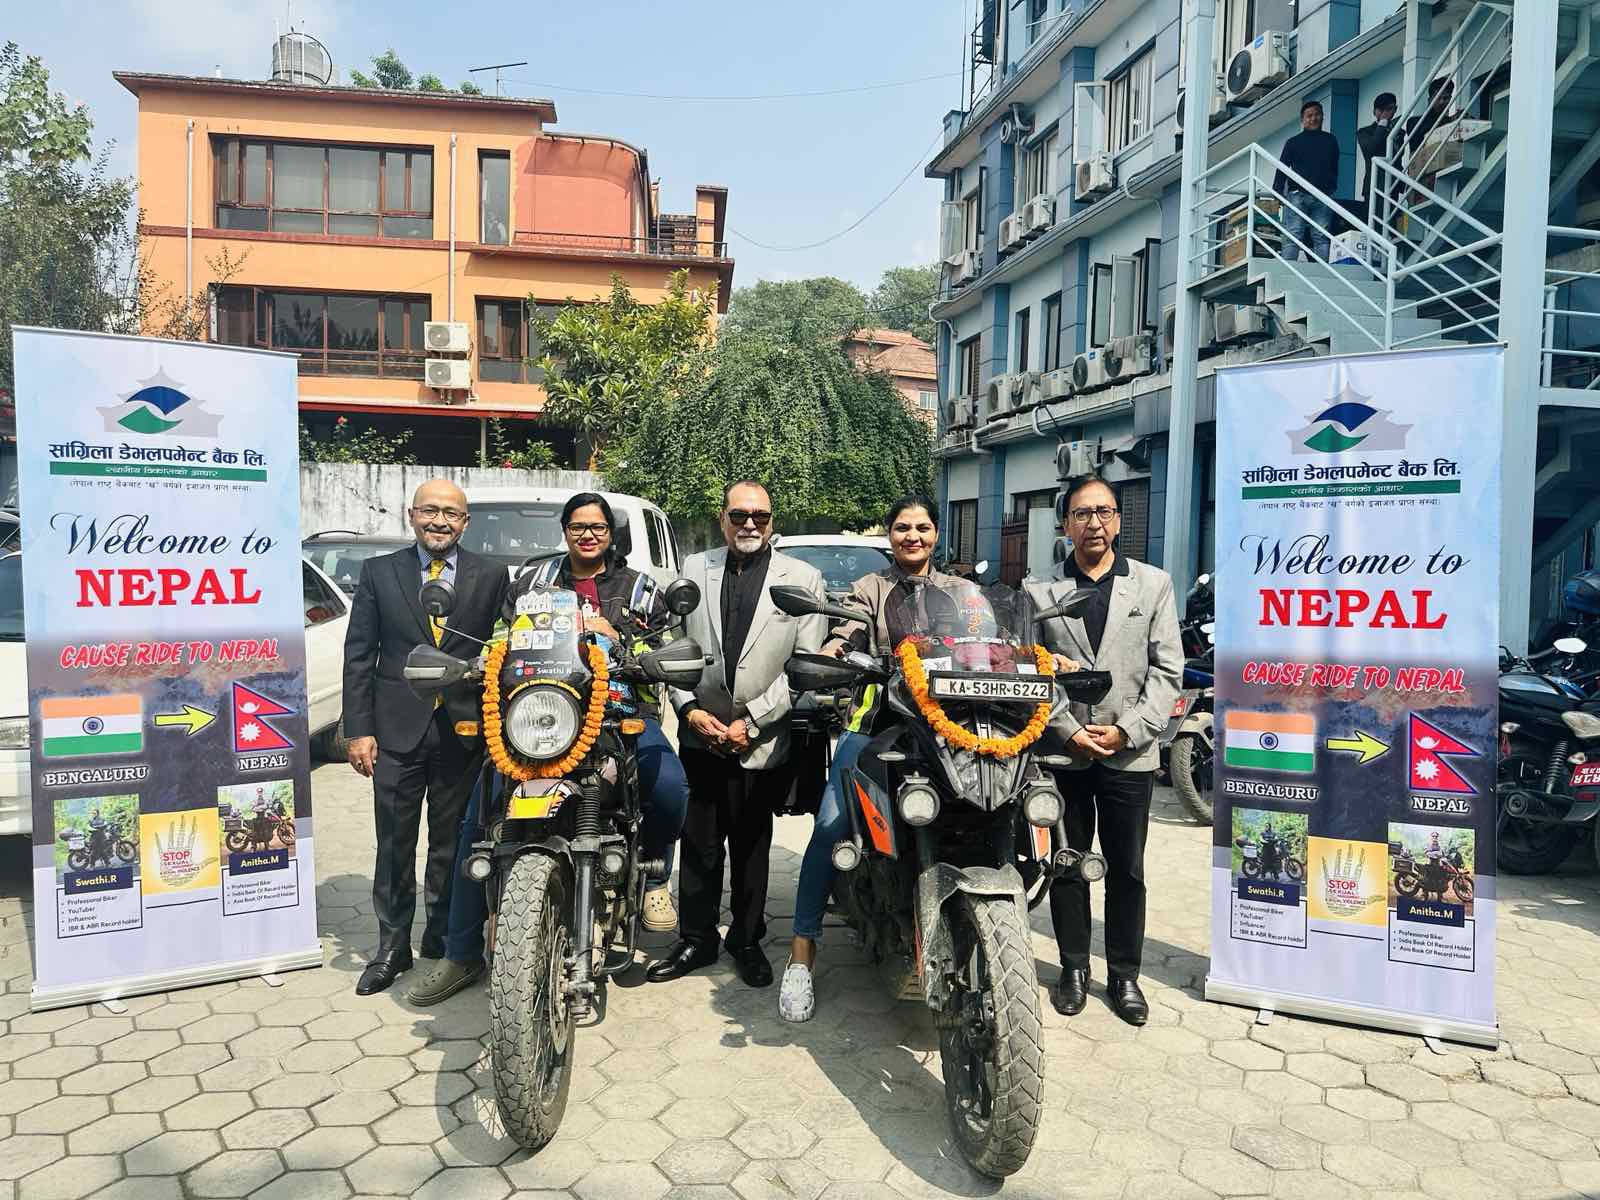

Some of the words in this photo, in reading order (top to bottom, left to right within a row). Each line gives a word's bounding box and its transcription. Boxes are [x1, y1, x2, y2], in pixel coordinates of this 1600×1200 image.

[119, 443, 208, 463] डेभलपमेन्ट
[1304, 461, 1393, 480] डेभलपमेन्ट
[50, 513, 230, 555] Welcome
[240, 528, 277, 555] to
[1240, 534, 1415, 576] Welcome
[1425, 544, 1470, 576] to
[75, 568, 262, 608] NEPAL
[1259, 589, 1448, 630] NEPAL
[60, 644, 132, 669] CAUSE
[135, 641, 185, 667] RIDE
[187, 641, 214, 665] TO
[219, 639, 279, 663] NEPAL
[1242, 662, 1304, 686] CAUSE
[1311, 665, 1360, 689] RIDE
[1362, 666, 1391, 689] TO
[1396, 668, 1466, 693] NEPAL
[949, 680, 1048, 697] KA-53HR-6242
[239, 756, 288, 771] NEPAL
[44, 767, 148, 785] BENGALURU
[1224, 780, 1318, 800] BENGALURU
[1413, 798, 1469, 813] NEPAL
[163, 851, 190, 861] STOP
[240, 856, 279, 868] Anitha.M
[75, 875, 117, 887] Swathi.R
[1328, 879, 1356, 890] STOP
[1247, 885, 1285, 898] Swathi.R
[1409, 905, 1453, 919] Anitha.M
